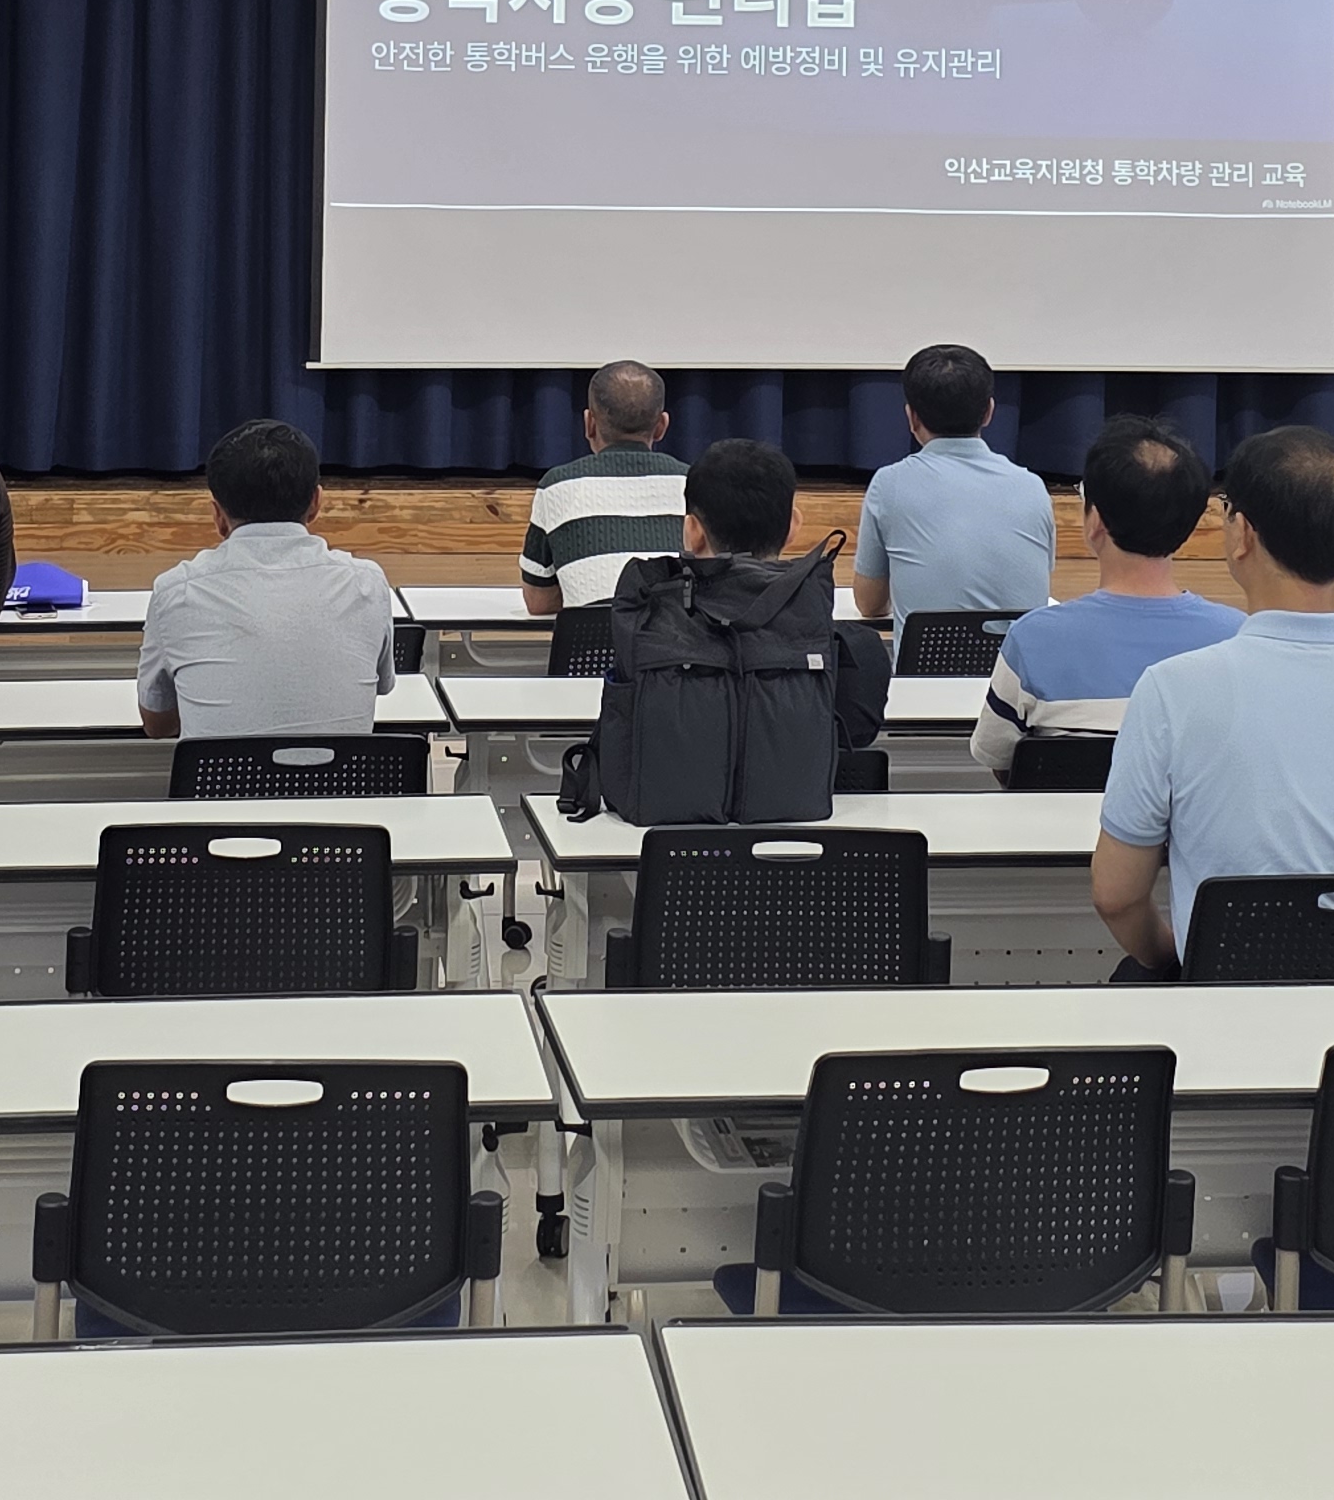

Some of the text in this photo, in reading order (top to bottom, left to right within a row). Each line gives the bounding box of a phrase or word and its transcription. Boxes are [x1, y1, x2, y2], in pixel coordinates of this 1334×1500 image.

[371, 40, 1001, 80] 안전한 통학버스 운행을 위한 예방정비 및 유지관리
[944, 157, 1307, 188] 익산교육지원청 통학차량 관리 교육
